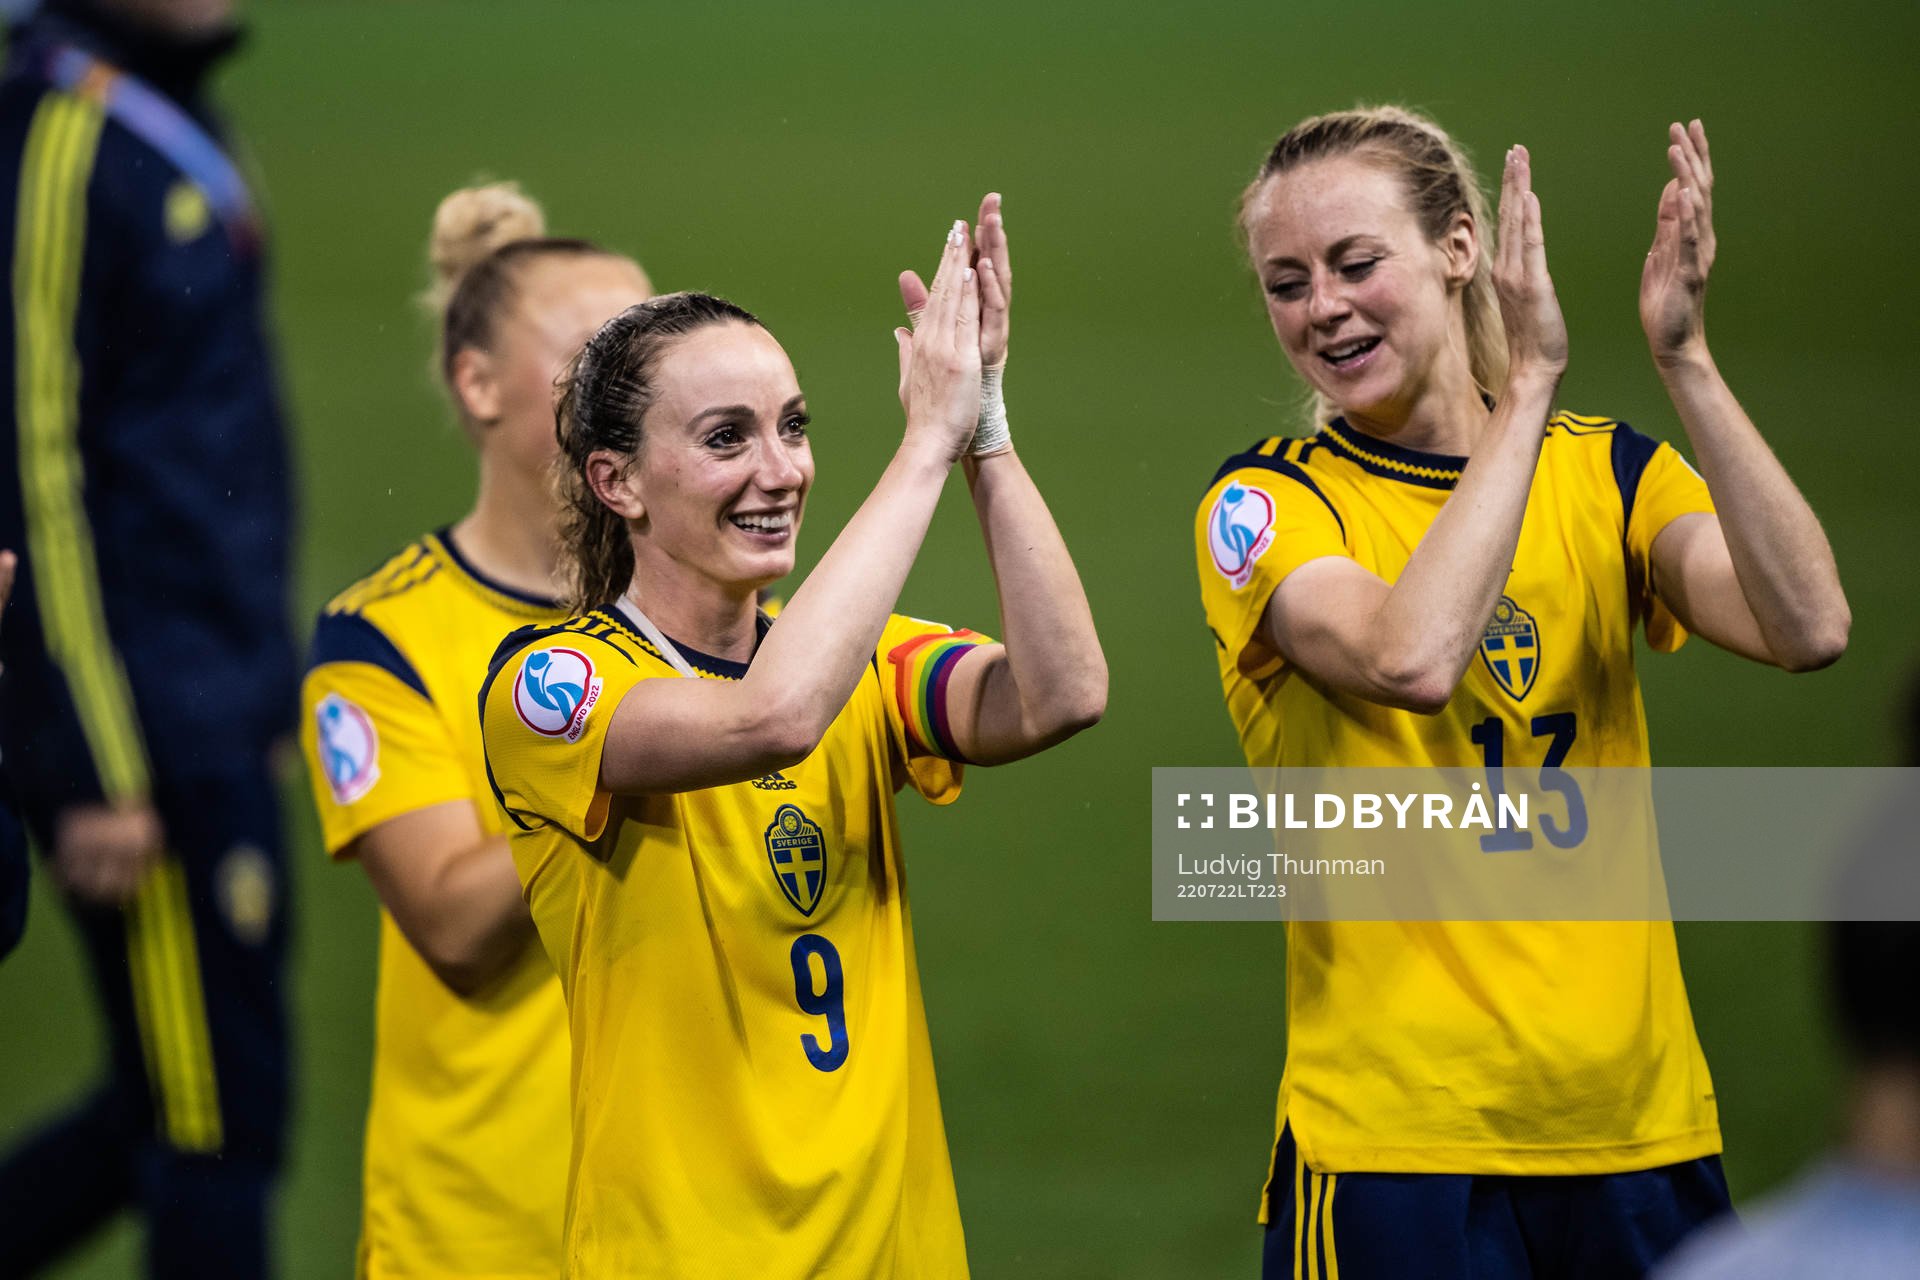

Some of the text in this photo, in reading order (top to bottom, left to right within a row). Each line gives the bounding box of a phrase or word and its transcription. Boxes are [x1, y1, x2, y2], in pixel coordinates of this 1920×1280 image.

[586, 684, 600, 708] 2022
[752, 776, 798, 791] adidas
[1471, 712, 1588, 853] 13
[776, 836, 813, 848] SVERIGE
[790, 933, 850, 1073] 9
